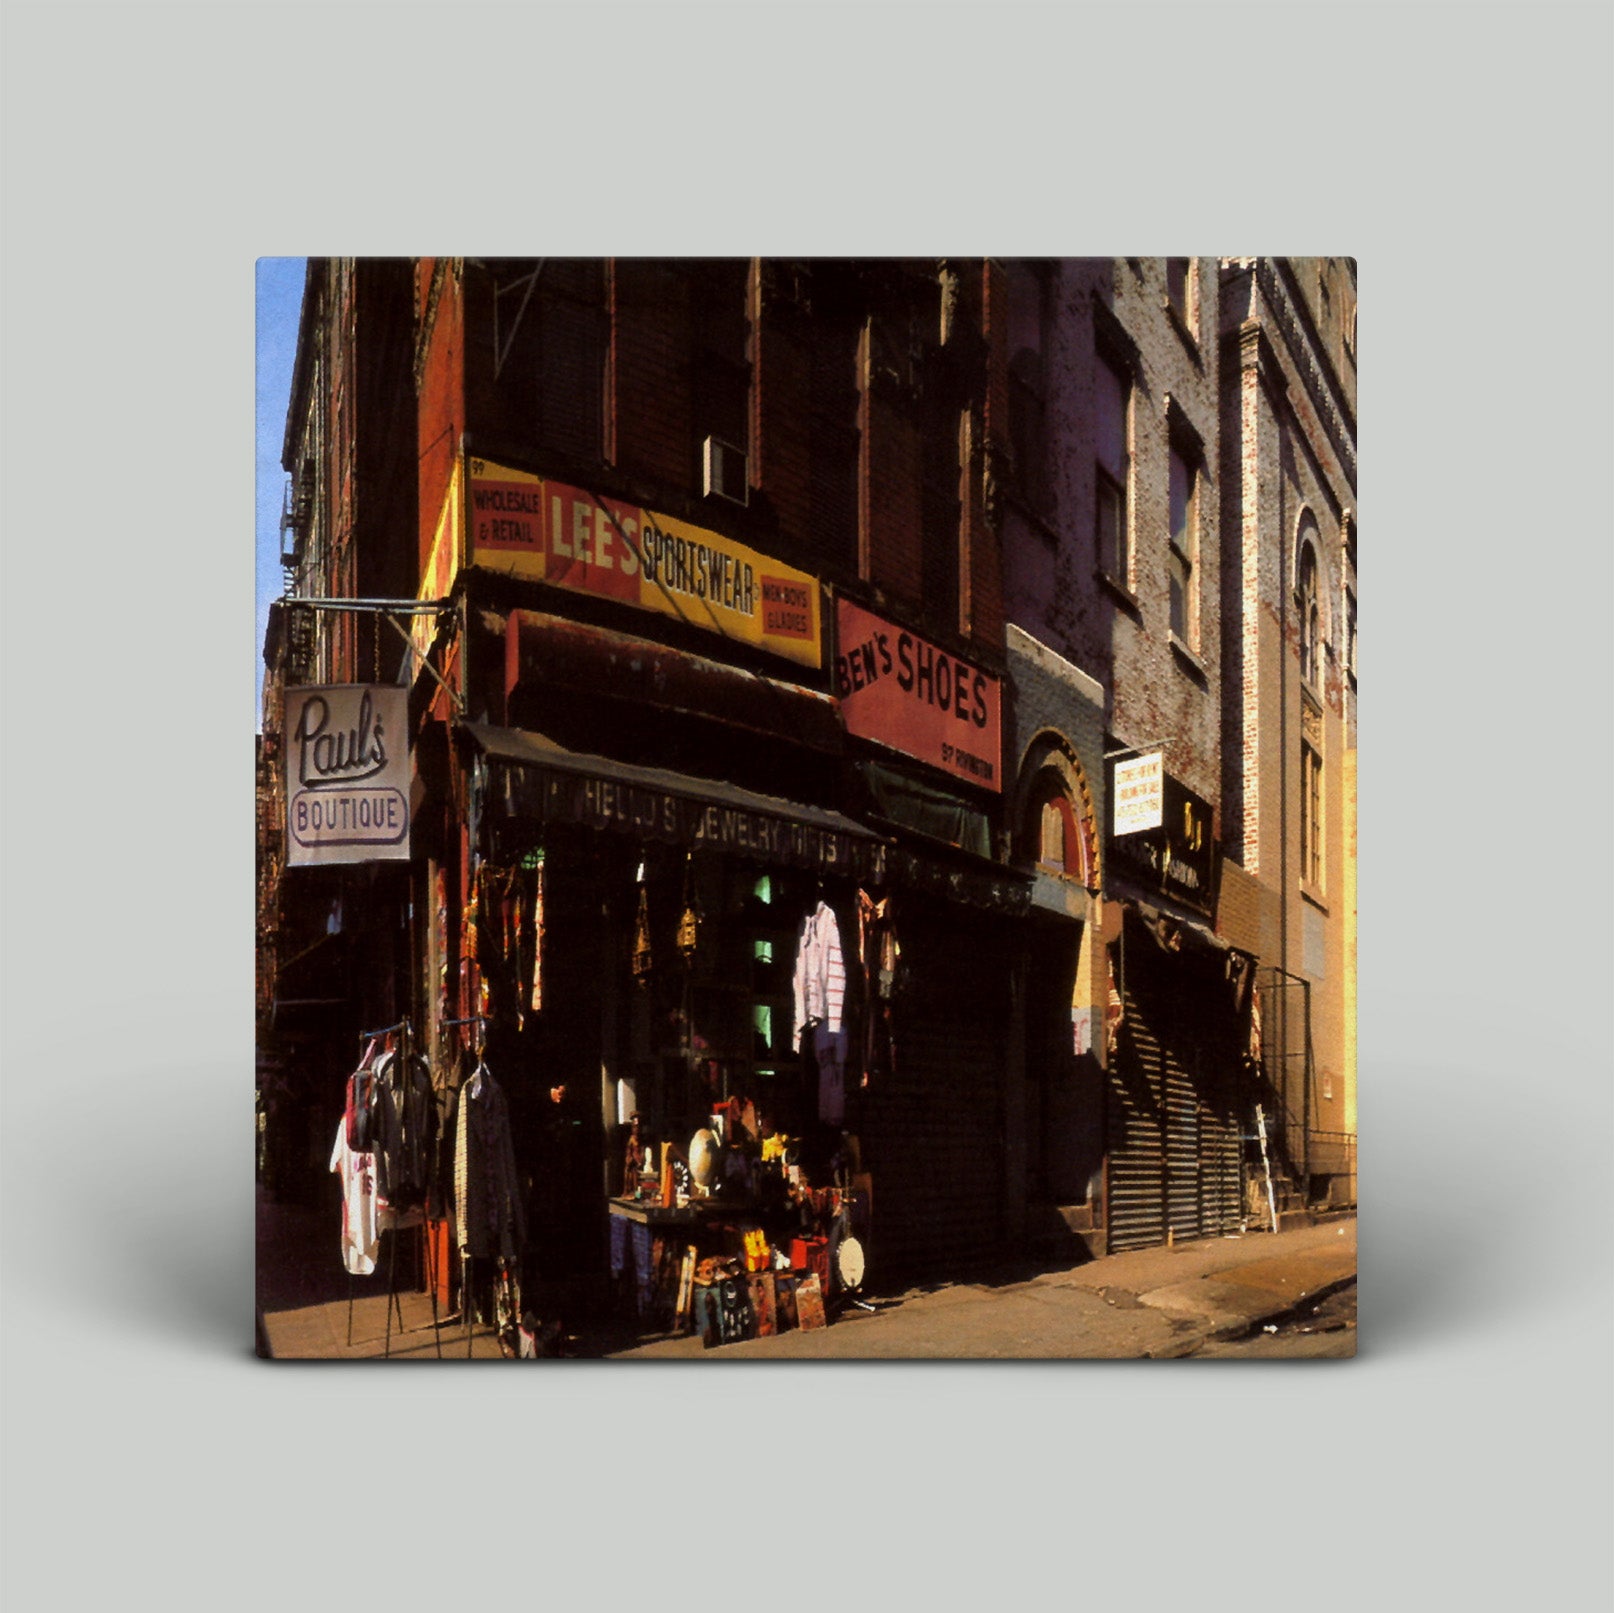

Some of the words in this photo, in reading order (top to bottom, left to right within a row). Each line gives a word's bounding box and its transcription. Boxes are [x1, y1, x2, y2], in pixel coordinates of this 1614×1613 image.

[474, 489, 539, 514] WHOLESALE
[492, 519, 534, 543] RETAIL
[552, 495, 639, 576] LEE'S
[643, 526, 754, 618] SPORTSWEAR
[835, 631, 892, 699] BEN'S
[897, 633, 987, 728] SHOES
[294, 689, 388, 788] Paul's
[297, 798, 399, 831] BOUTIQUE
